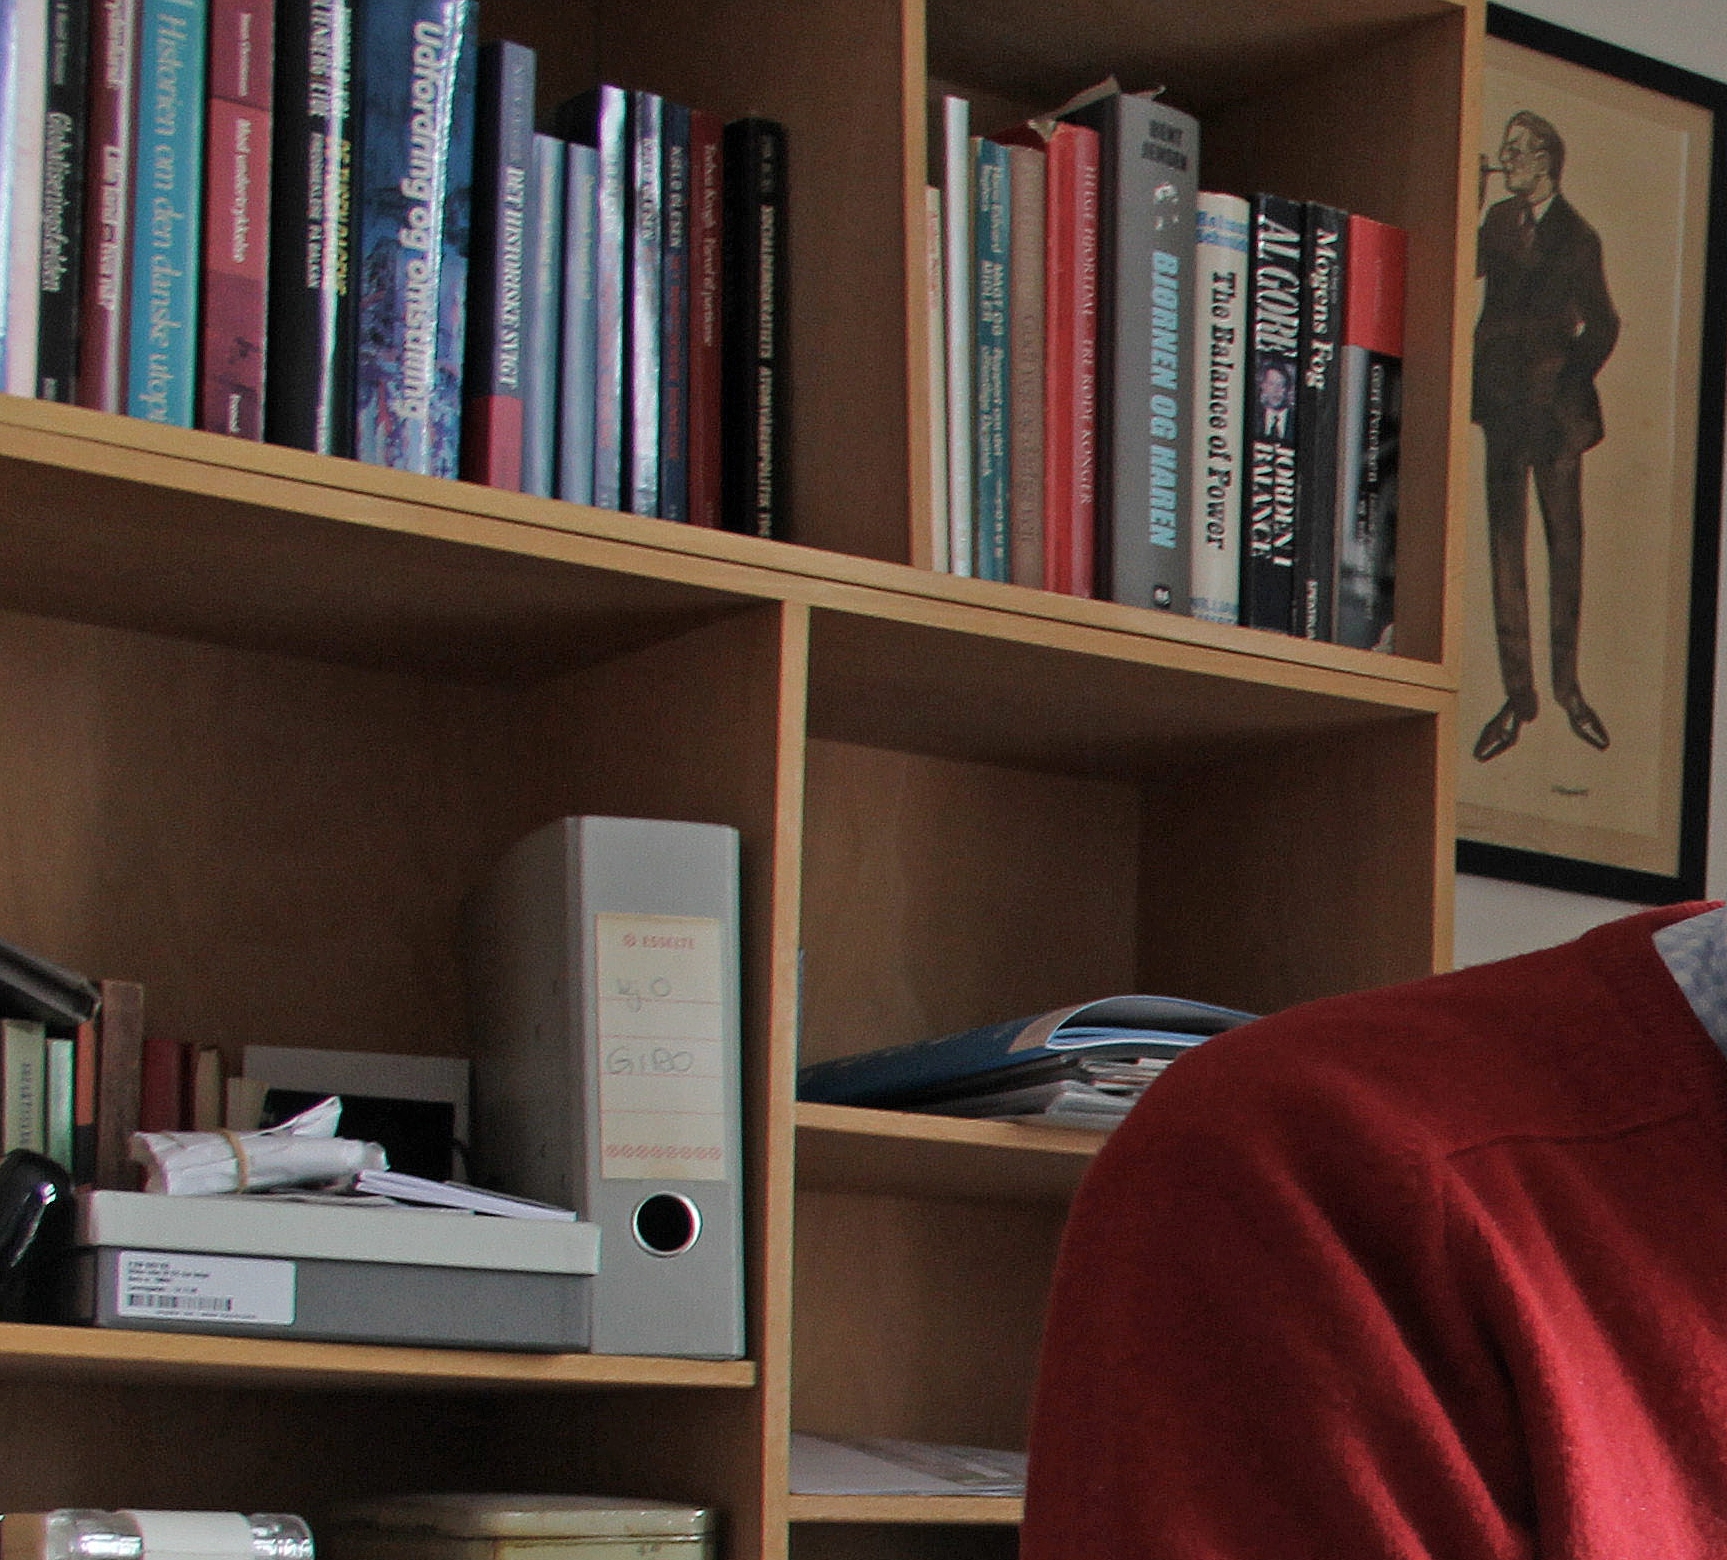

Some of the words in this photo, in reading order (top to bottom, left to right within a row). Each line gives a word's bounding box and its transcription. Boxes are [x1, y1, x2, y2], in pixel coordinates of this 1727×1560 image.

[154, 13, 188, 136] Historien
[400, 21, 445, 201] Udfordring
[152, 144, 176, 190] om
[504, 165, 526, 208] DET
[151, 197, 184, 248] den
[398, 206, 432, 250] og
[1257, 215, 1301, 260] AL
[147, 254, 183, 347] danske
[501, 210, 523, 328] HISTORISKE
[759, 204, 775, 359] SOCIALDEMOKRATIETS
[1211, 270, 1237, 319] The
[1309, 226, 1339, 335] Mogens
[391, 260, 434, 420] omstilling
[1150, 250, 1179, 388] BJØRNEN
[1255, 265, 1300, 359] GORE
[498, 329, 521, 391] SVIGT
[1208, 323, 1236, 428] Balance
[1304, 337, 1335, 390] Fog
[1368, 364, 1385, 402] Gert
[1150, 393, 1178, 438] OG
[1208, 434, 1234, 464] of
[1366, 408, 1383, 483] Petersen
[1079, 428, 1094, 506] KONGER
[1149, 444, 1177, 549] HAREN
[1250, 440, 1274, 559] BALANCE
[1272, 442, 1295, 548] JORDEN
[1204, 466, 1231, 551] Power
[1272, 551, 1294, 568] I
